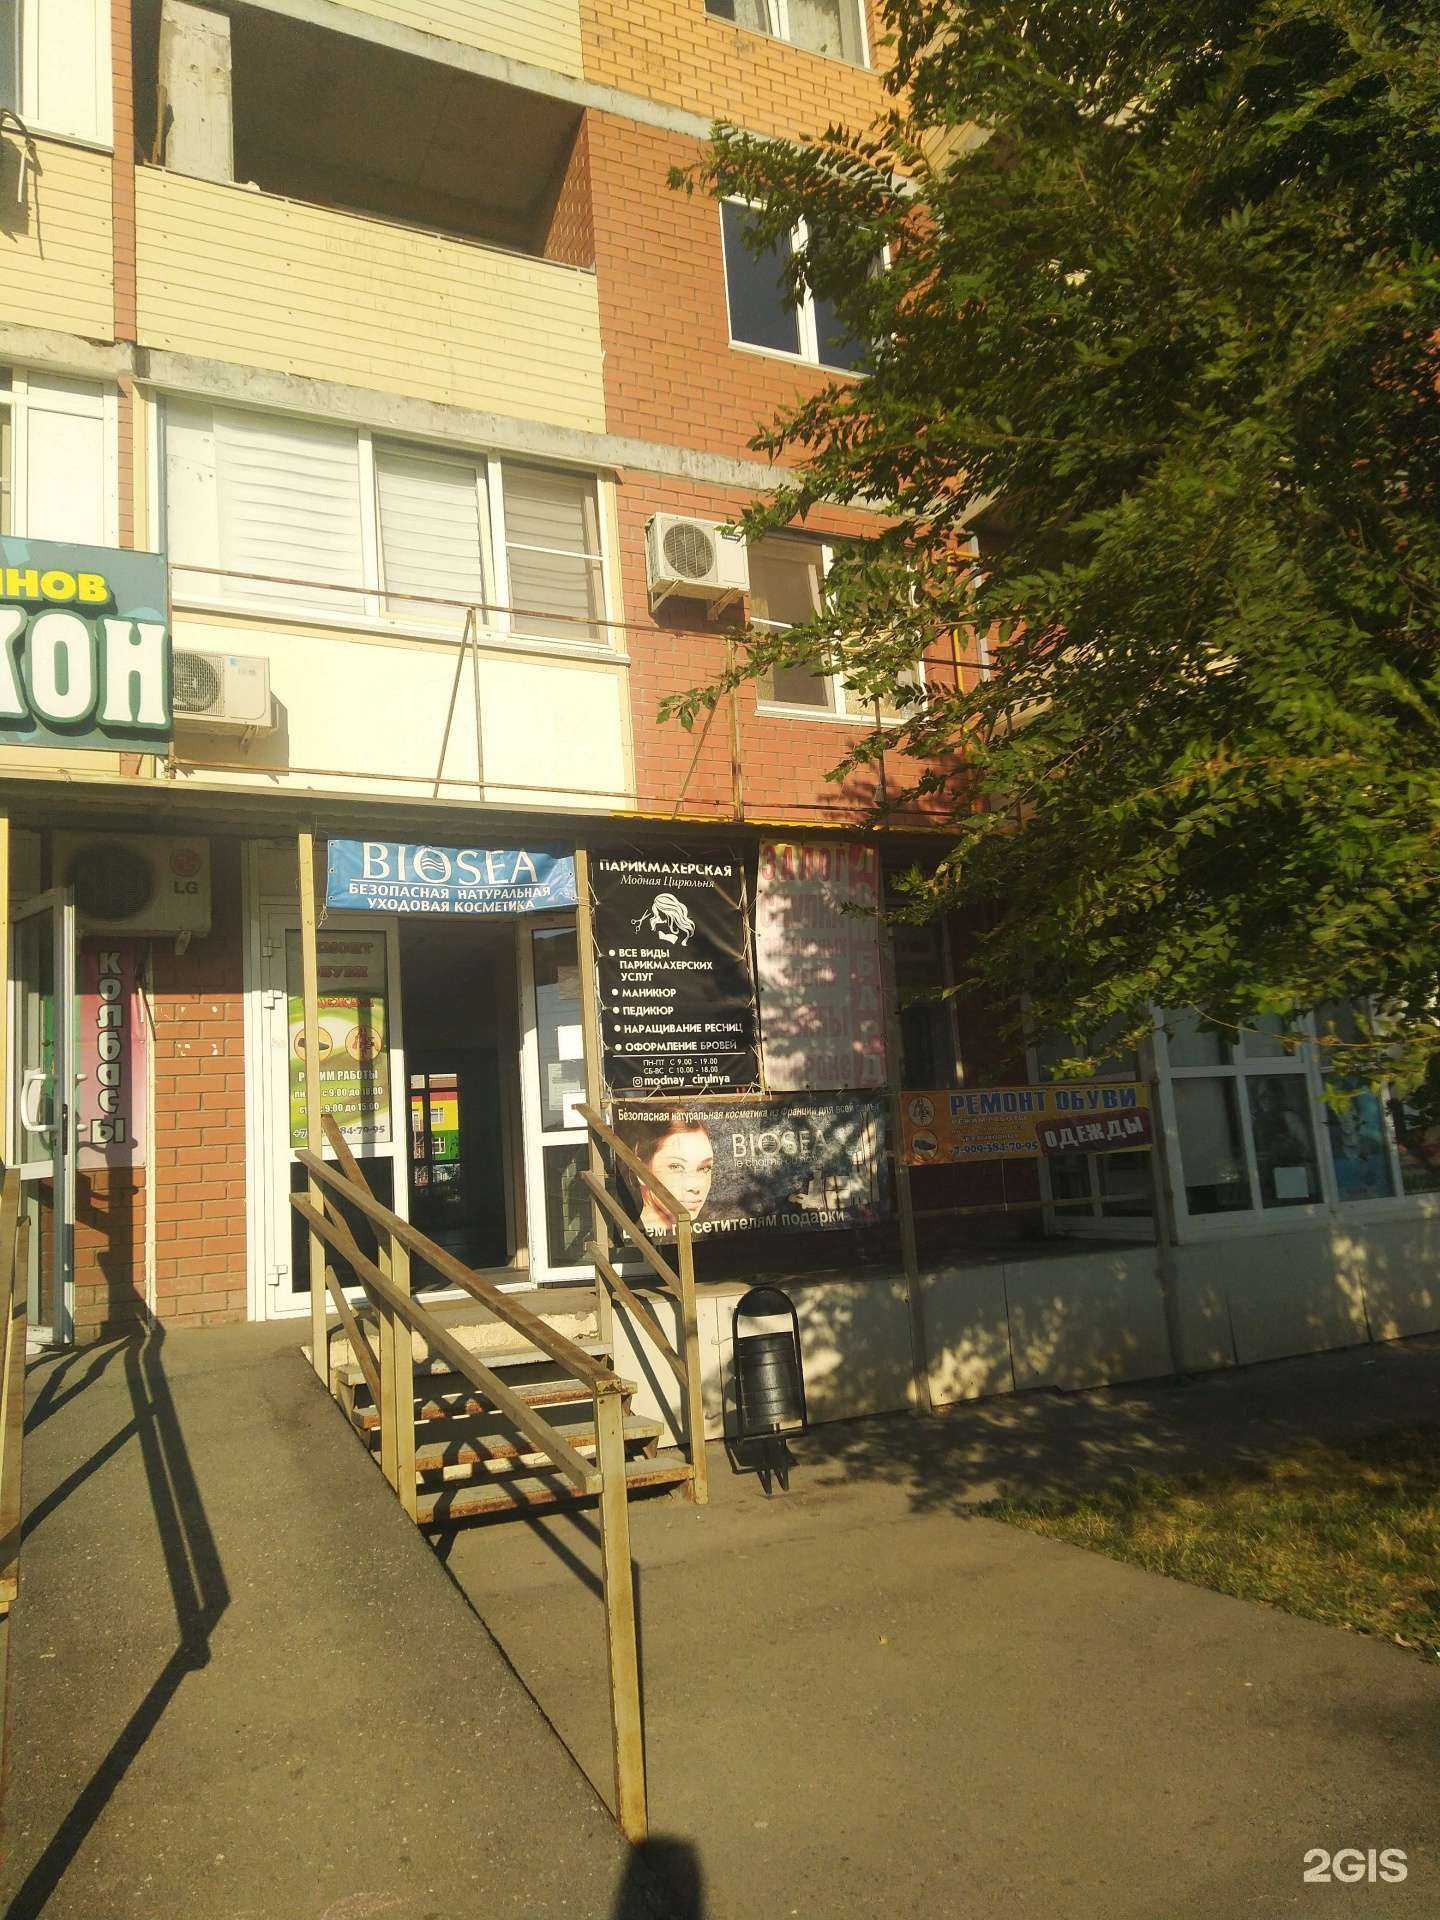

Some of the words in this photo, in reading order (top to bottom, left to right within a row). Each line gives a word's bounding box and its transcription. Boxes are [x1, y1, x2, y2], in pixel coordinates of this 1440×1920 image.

[0, 568, 108, 602] НОВ
[362, 842, 538, 885] BIOSEA
[599, 860, 732, 877] ПАРИКМАХЕРСКАЯ
[173, 880, 199, 895] LG
[620, 875, 661, 887] Модная
[663, 876, 715, 889] Цирюльня
[349, 883, 449, 899] БЕЗОПАСНАЯ
[457, 886, 551, 900] НАТУРАЛЬНАЯ
[367, 897, 450, 913] УХОДОВАЯ
[454, 899, 536, 913] КОСМЕТИКА
[618, 949, 638, 958] ВСЕ
[640, 949, 670, 959] ВИДЫ
[619, 960, 713, 971] ПАРИКМАХЕРСКИХ
[620, 972, 654, 982] УСЛУГ
[622, 988, 677, 998] МАНИКЮР
[622, 1006, 674, 1017] ПЕДИКЮР
[624, 1023, 702, 1035] НАРАЩИВАНИЕ
[704, 1023, 744, 1033] РЕСНИЦ
[625, 1041, 698, 1052] ОФОРМЛЕНИЕ
[700, 1040, 737, 1051] БРОВЕЙ
[677, 1058, 692, 1066] 9.00
[700, 1058, 718, 1066] 19.00
[298, 1070, 336, 1083] РИМ
[337, 1069, 379, 1081] РАБОТЫ
[643, 1067, 665, 1075] СБ-ВС
[950, 1089, 1046, 1116] РЕМОНТ
[1055, 1087, 1138, 1111] ОБУВИ
[618, 1108, 670, 1121] Безопасная
[672, 1109, 724, 1122] натуральная
[725, 1108, 768, 1120] косметика
[1044, 1116, 1145, 1149] ОДЕЖДЫ
[732, 1130, 827, 1159] BIOSEA
[672, 1212, 778, 1237] псетителям
[782, 1207, 845, 1228] подарки
